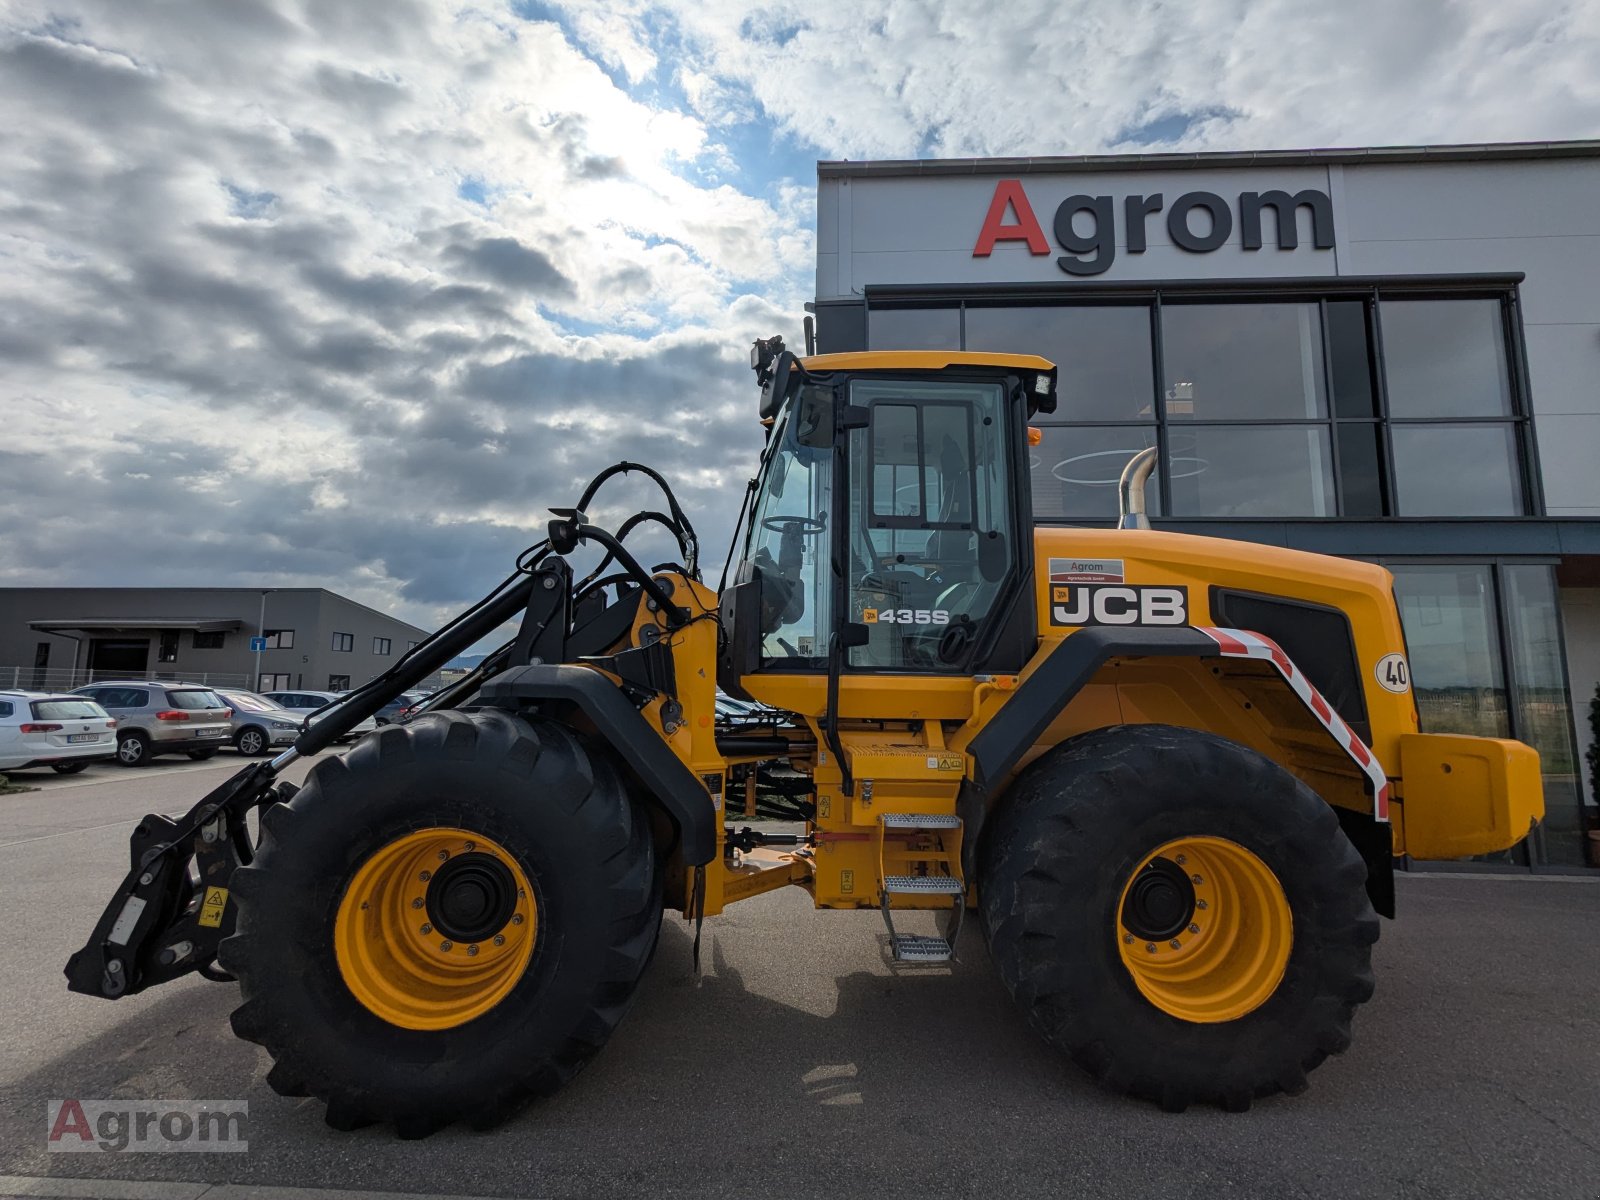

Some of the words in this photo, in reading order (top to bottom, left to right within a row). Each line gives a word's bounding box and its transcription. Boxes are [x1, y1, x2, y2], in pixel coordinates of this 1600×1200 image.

[972, 179, 1335, 276] Agrom
[1071, 562, 1103, 572] Agrom
[879, 609, 950, 625] 435S
[1053, 587, 1186, 625] JCB
[1386, 661, 1407, 685] 40
